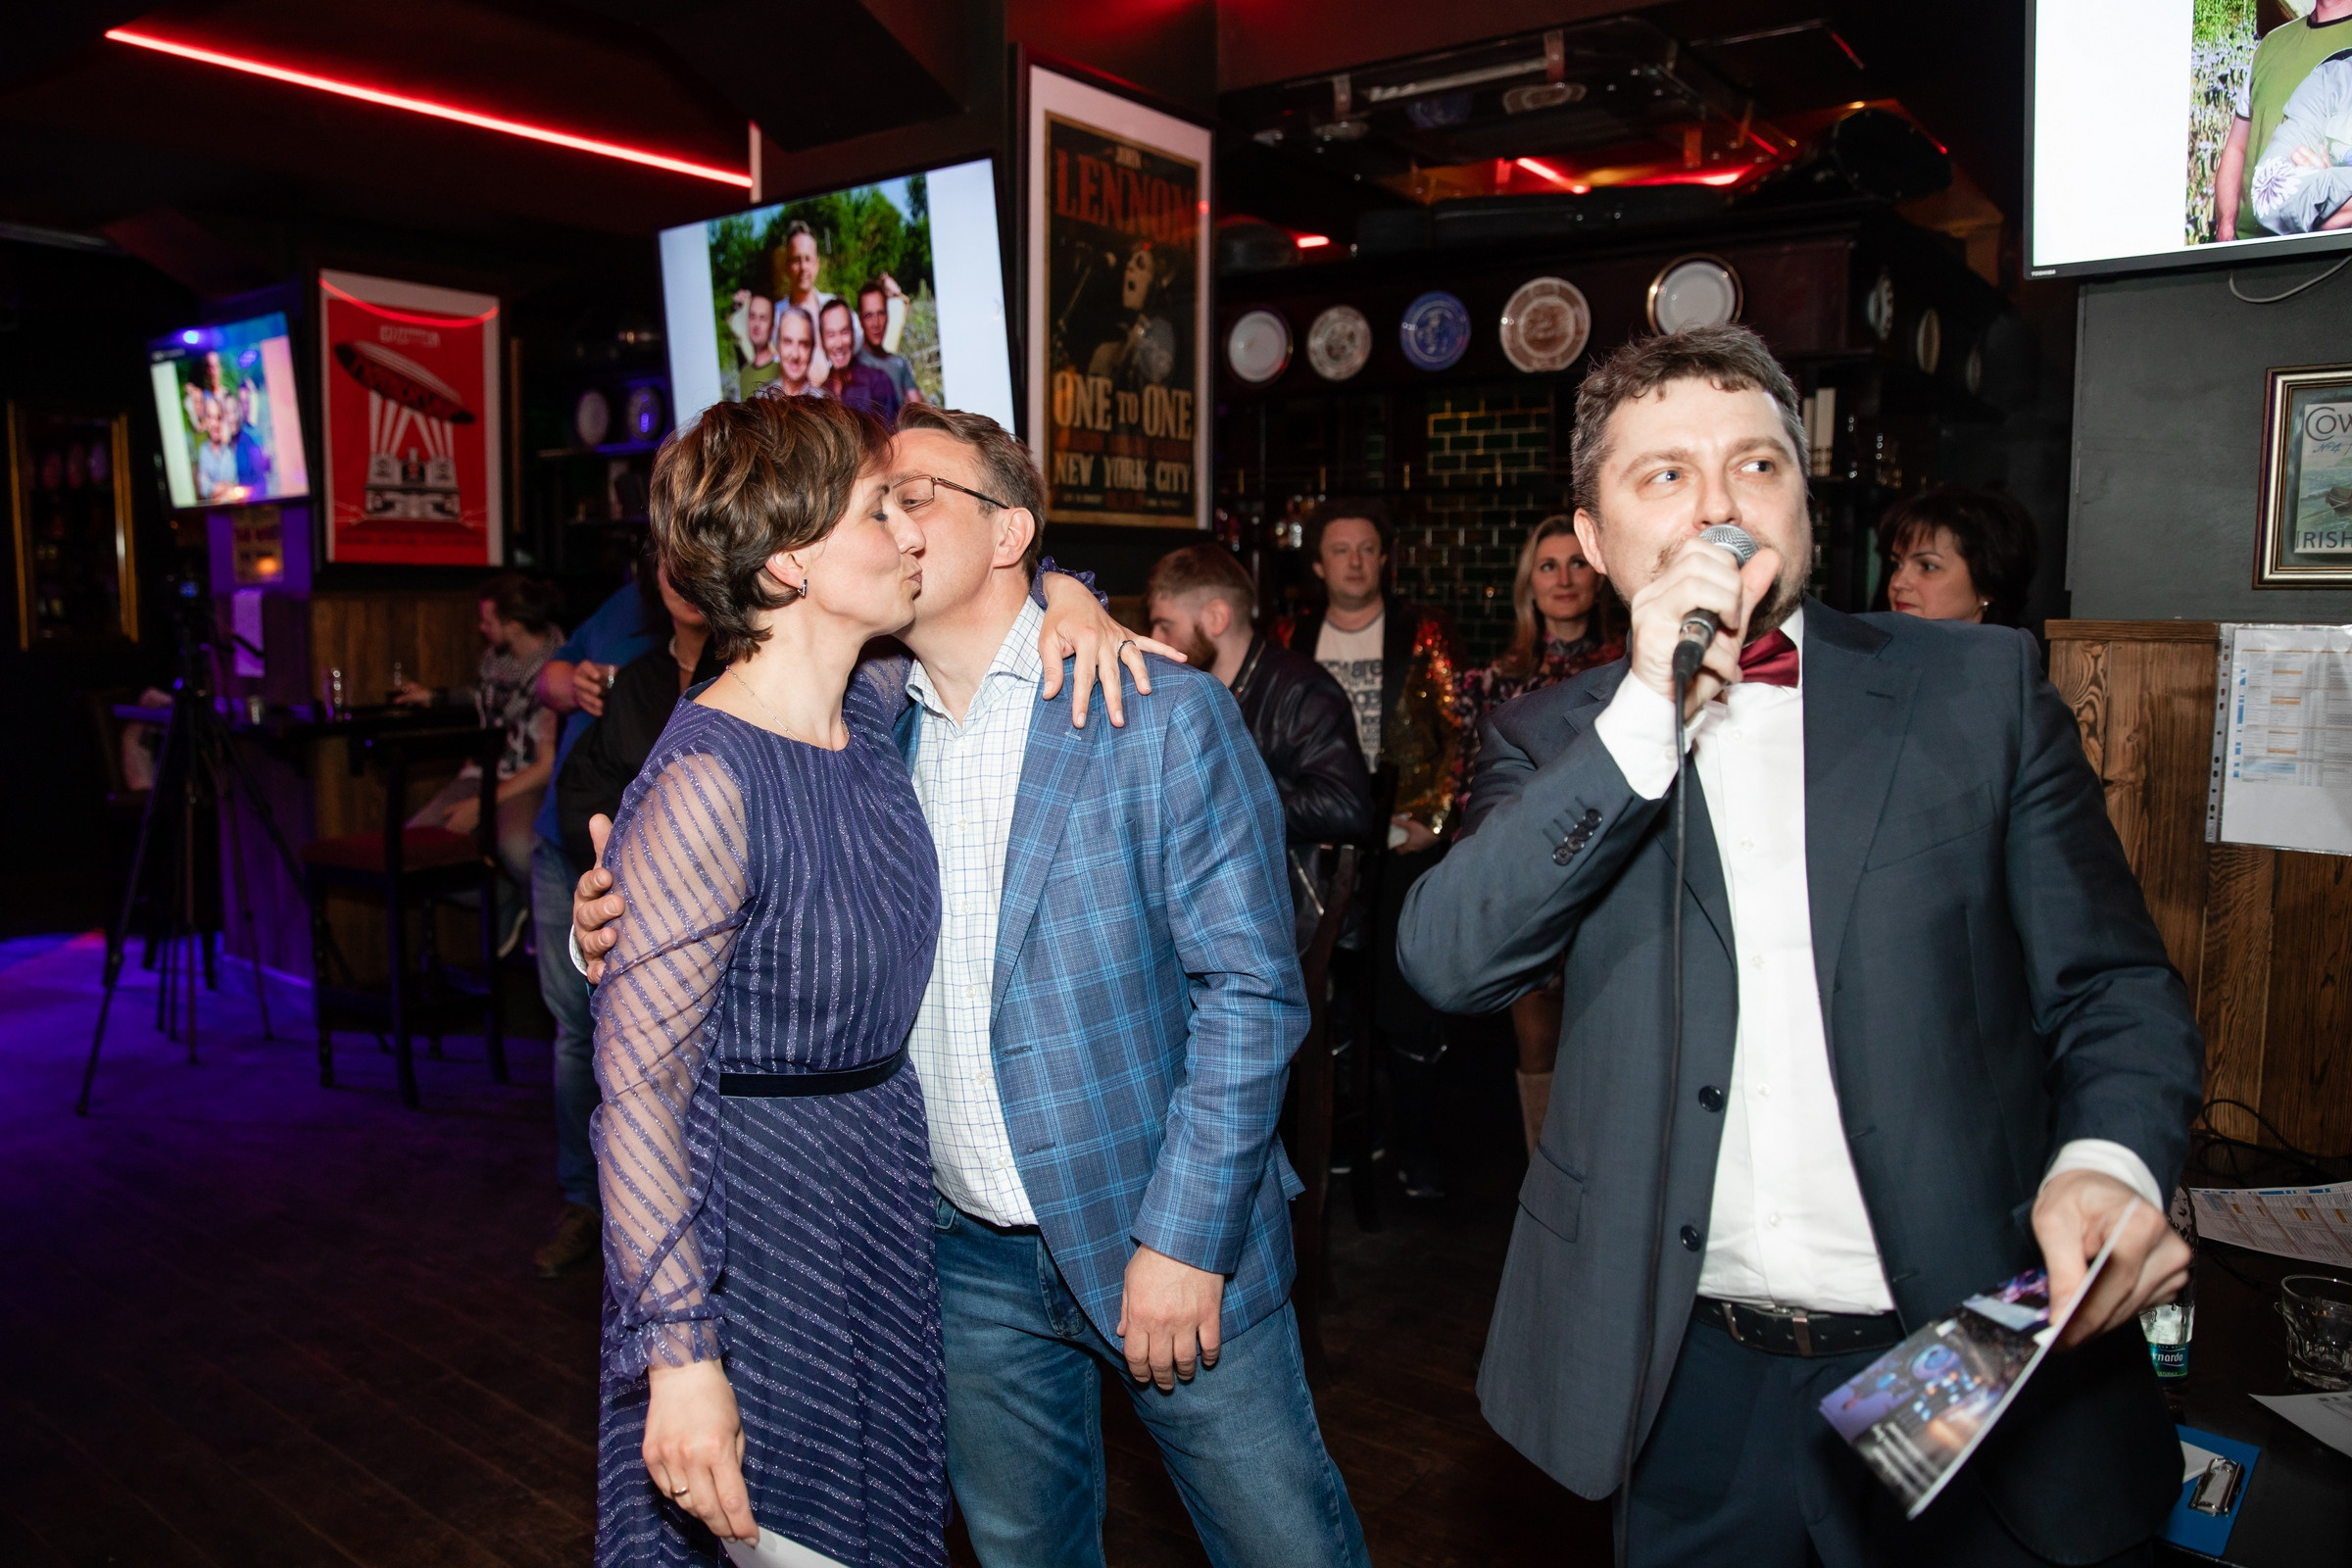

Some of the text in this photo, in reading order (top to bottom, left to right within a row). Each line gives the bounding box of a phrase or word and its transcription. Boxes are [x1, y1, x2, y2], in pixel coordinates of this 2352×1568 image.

[1054, 146, 1196, 249] LENNON
[1054, 369, 1193, 441] ONE TO ONE
[1054, 451, 1192, 494] NEW YORK CITY
[2296, 530, 2352, 549] IRISH
